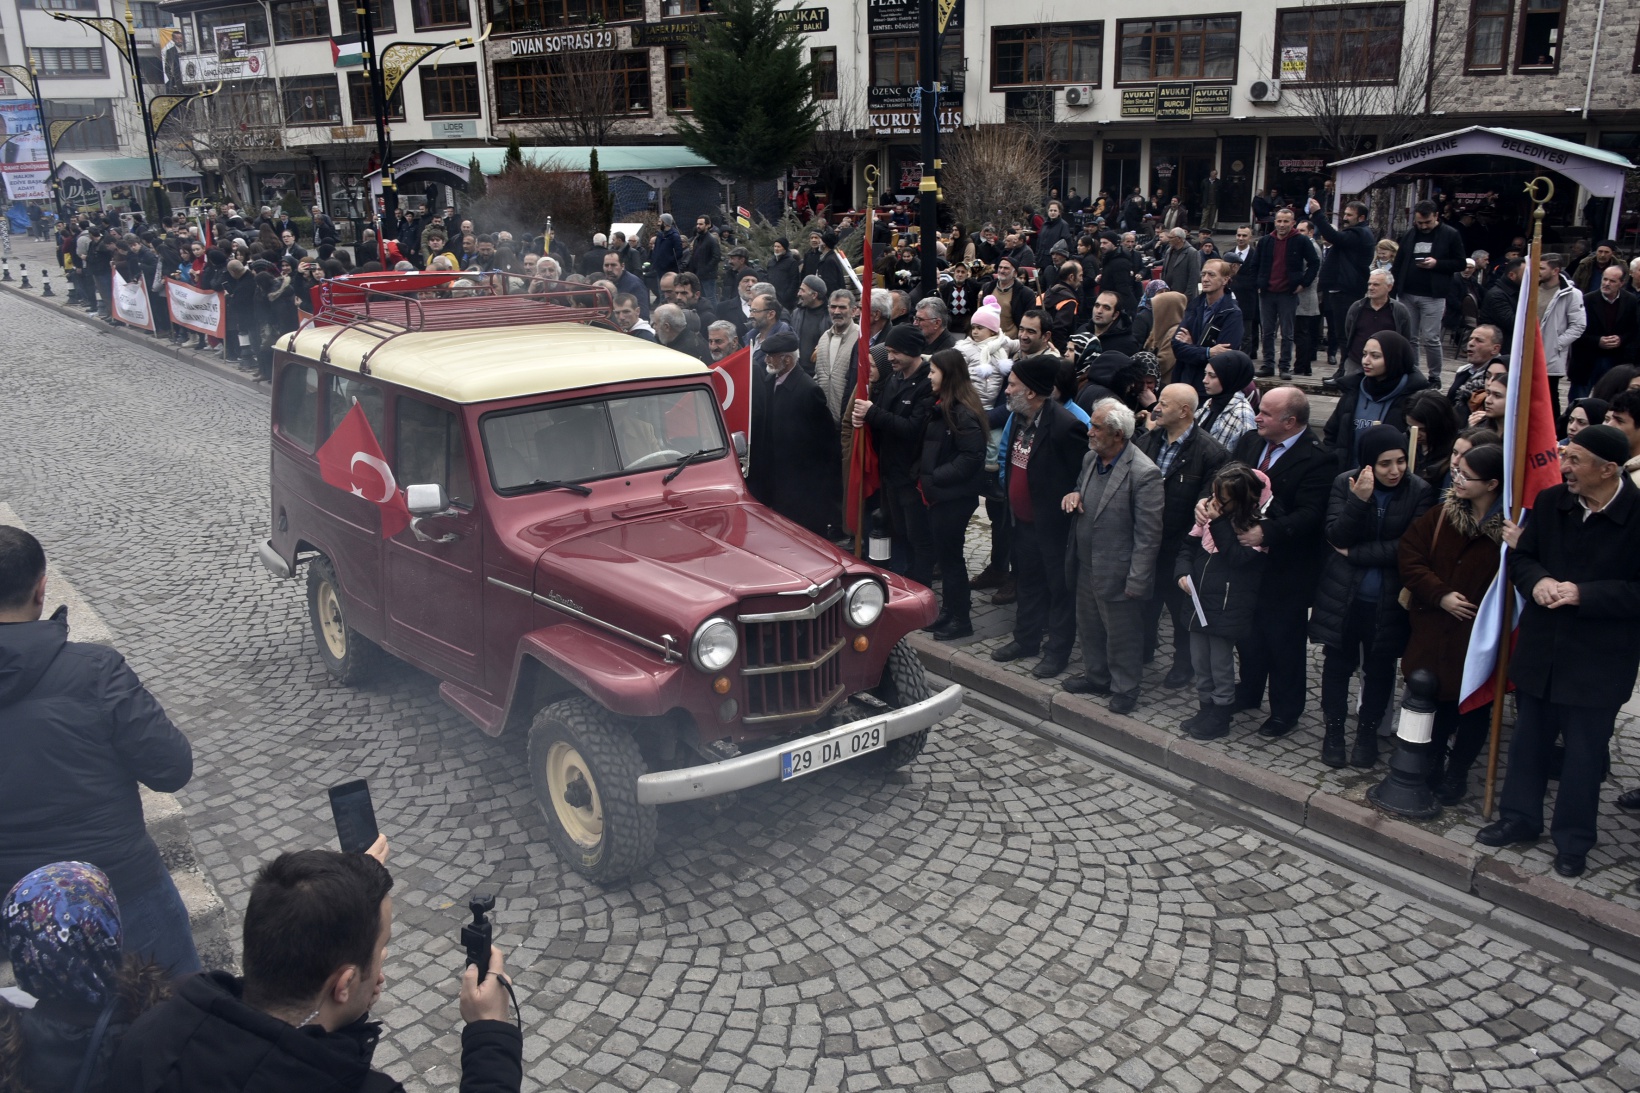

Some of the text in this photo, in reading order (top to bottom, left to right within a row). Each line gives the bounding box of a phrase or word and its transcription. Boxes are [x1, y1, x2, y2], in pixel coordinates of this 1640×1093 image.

[545, 33, 594, 52] SOFRASI
[596, 31, 612, 48] 29
[872, 87, 902, 97] ÖZENÇ
[1160, 88, 1190, 96] AVUKAT
[1196, 90, 1229, 98] AVUKAT
[869, 108, 962, 128] KURUYMİŞ
[1501, 139, 1569, 165] BELEDİYESİ
[792, 728, 880, 773] 29 DA 029
[783, 766, 792, 775] TR
